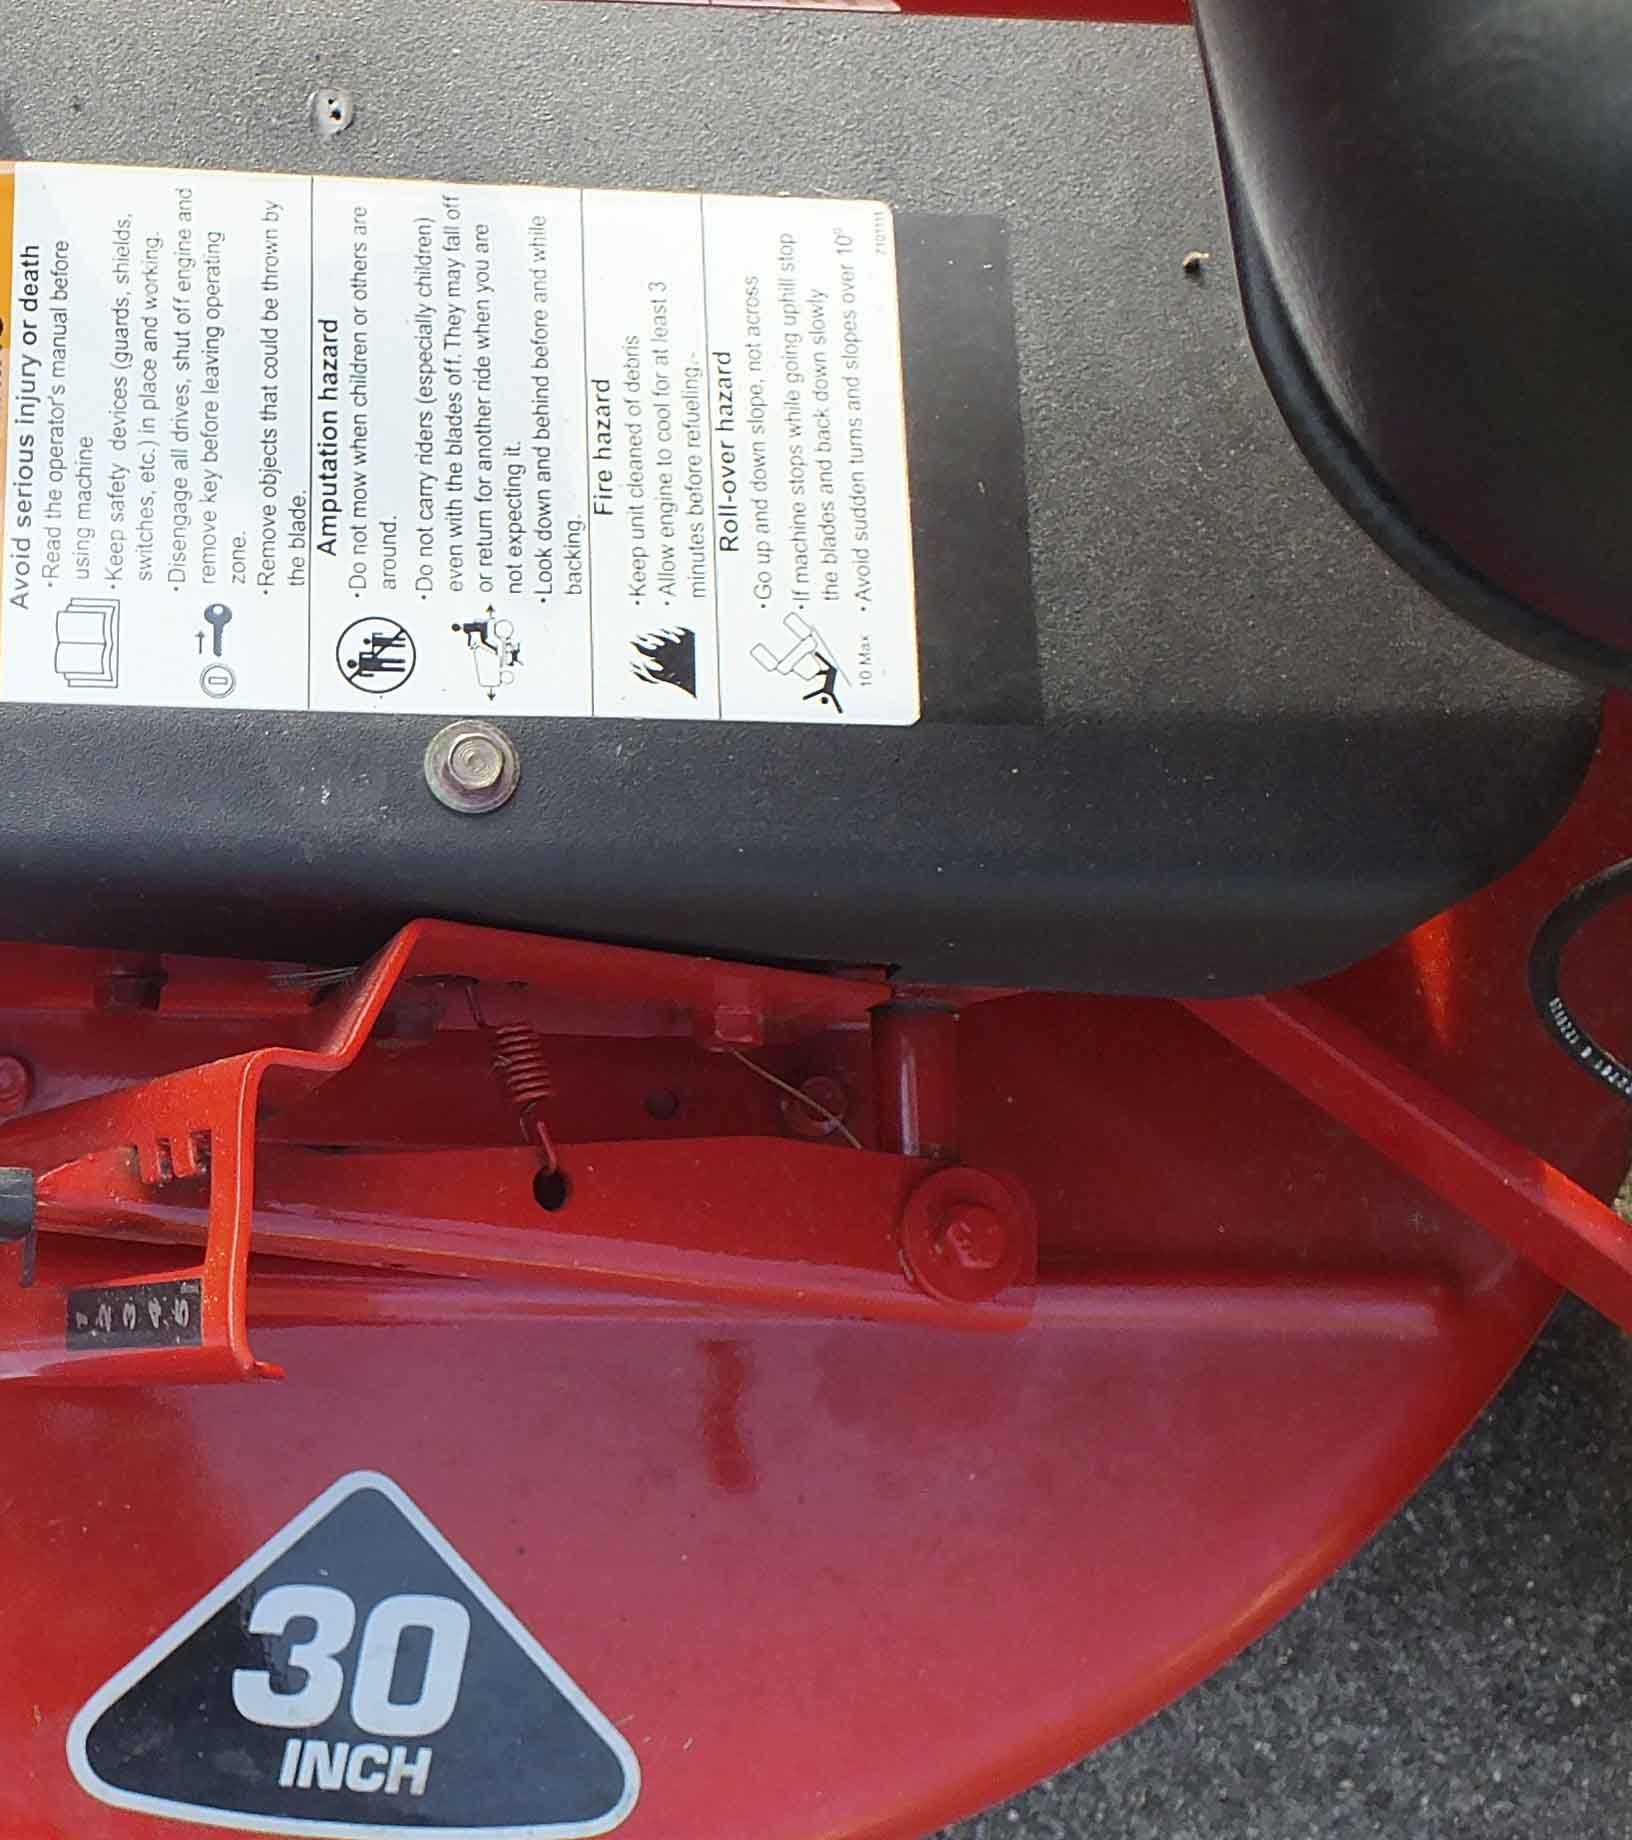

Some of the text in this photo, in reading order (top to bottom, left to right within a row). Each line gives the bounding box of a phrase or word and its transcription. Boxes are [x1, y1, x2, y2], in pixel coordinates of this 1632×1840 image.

[10, 246, 42, 609] Avoid serious injury or death
[42, 240, 69, 578] Read the operator's manual before
[72, 436, 95, 579] using machine
[104, 214, 133, 580] Keep safety devices (guards, shields,
[168, 188, 196, 582] Disengage all drives, shut off engine and
[198, 232, 225, 583] remove key before leaving operating
[257, 202, 283, 586] Remove objects that could be thrown by
[317, 320, 342, 556] Amputation hazard
[348, 207, 368, 589] Do not mow when children or others are
[414, 218, 438, 591] Do not carry riders (especially children)
[472, 224, 495, 592] or return for another ride when you are
[503, 442, 527, 594] not expecting it.
[591, 380, 613, 515] Fire hazard
[622, 336, 650, 596] Keep unit cleaned of debris
[681, 362, 706, 598] minutes before refueling.
[713, 352, 739, 551] Roll-over hazard
[806, 289, 840, 600] the blades and back down slowly
[858, 636, 872, 686] 10 Max
[232, 1584, 472, 1738] 30
[279, 1738, 433, 1797] INCH
